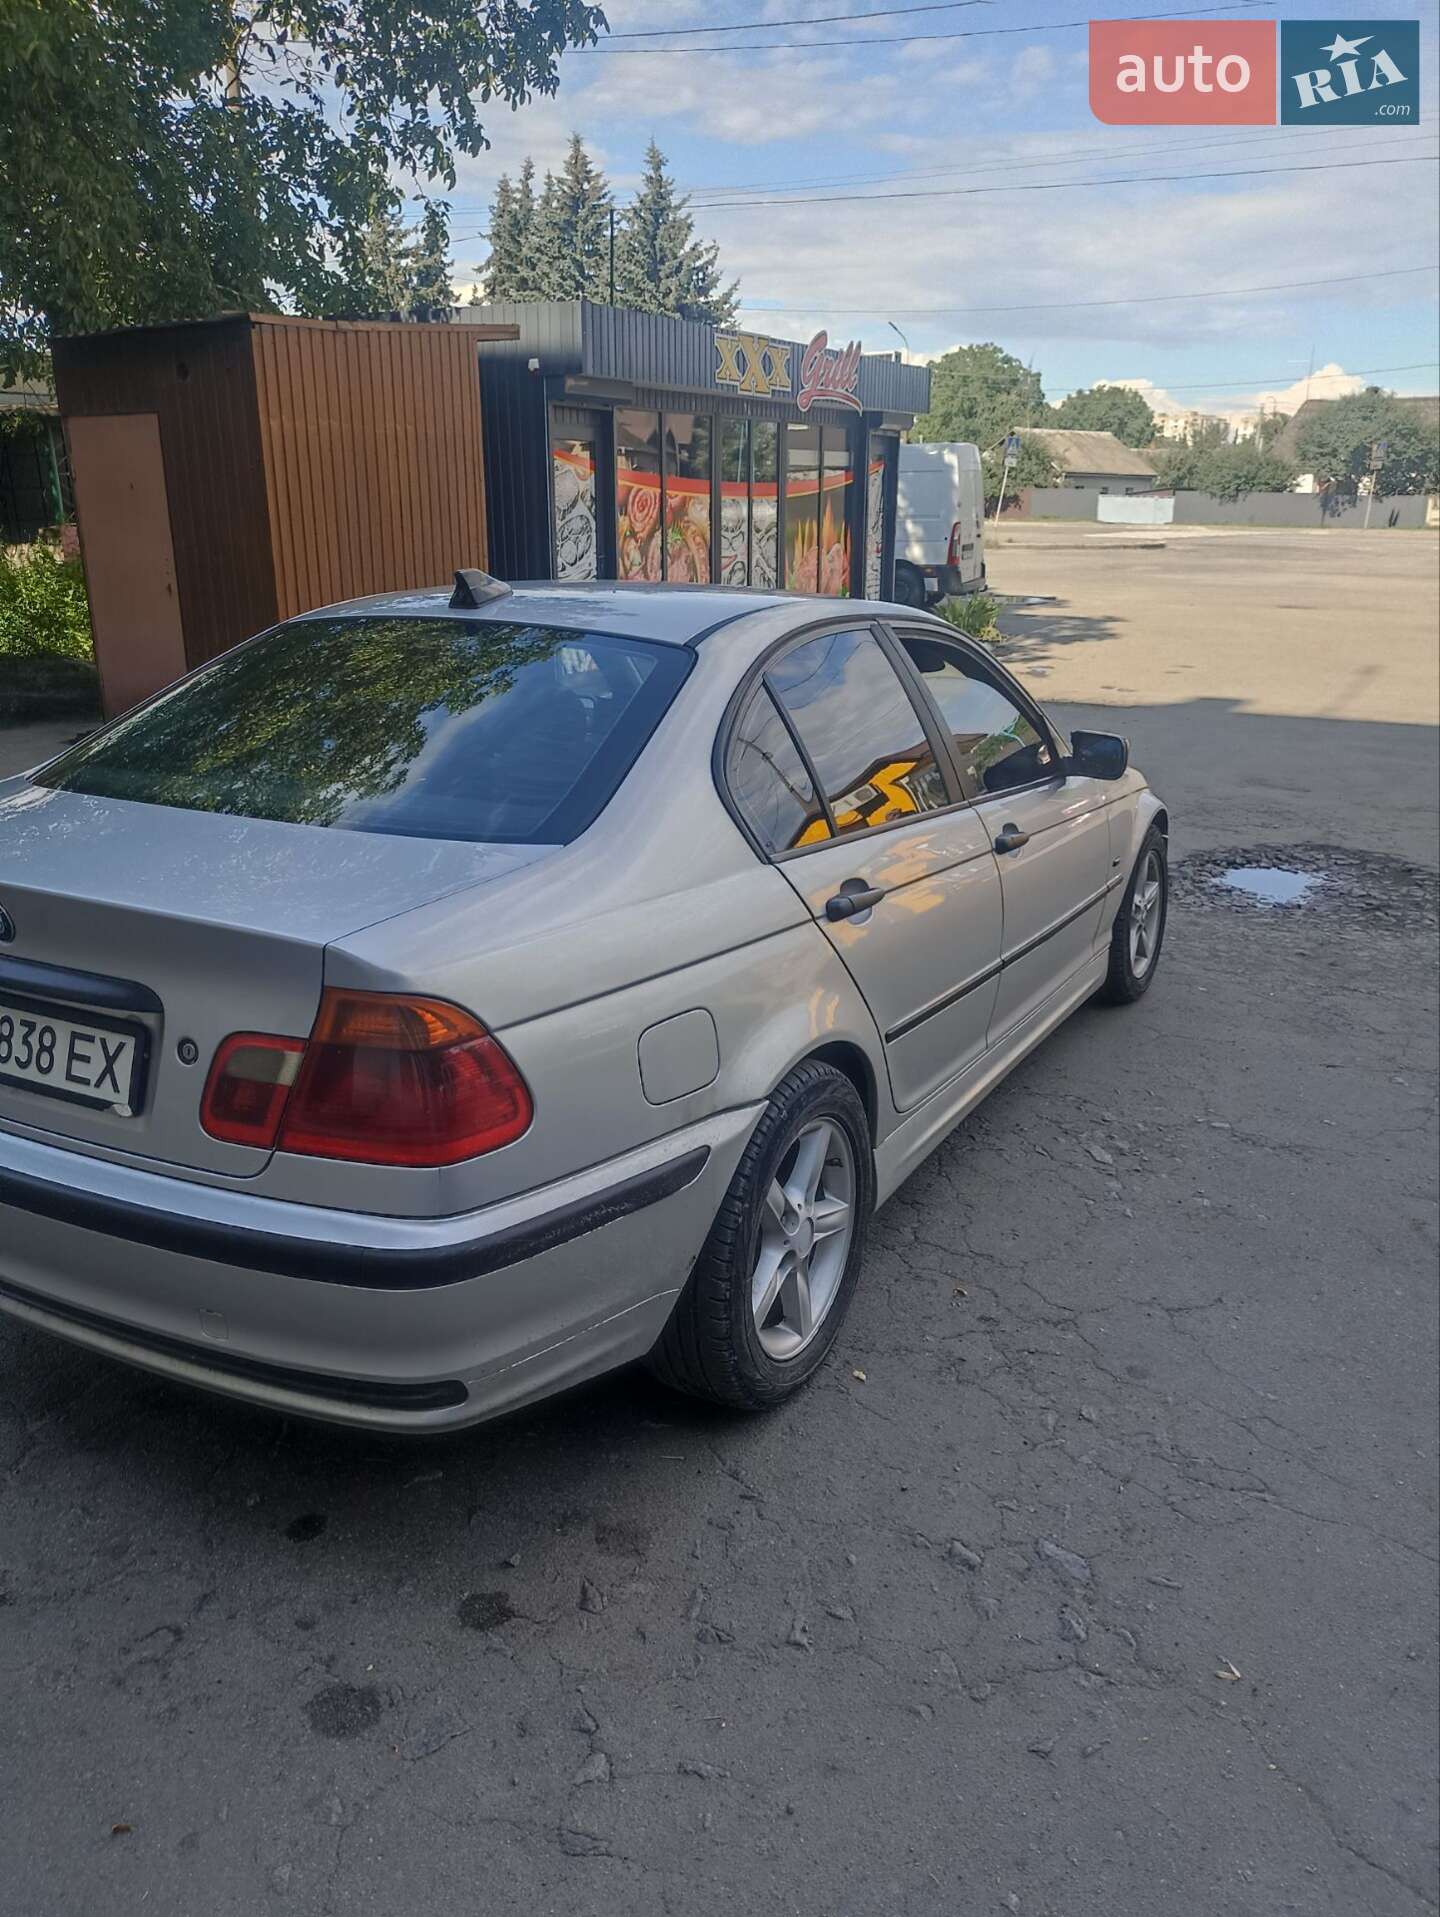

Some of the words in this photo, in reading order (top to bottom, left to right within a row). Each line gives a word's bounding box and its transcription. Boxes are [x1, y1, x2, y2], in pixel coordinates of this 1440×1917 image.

[797, 329, 863, 416] Grill
[0, 1015, 57, 1075] 838
[65, 1030, 127, 1094] EX
